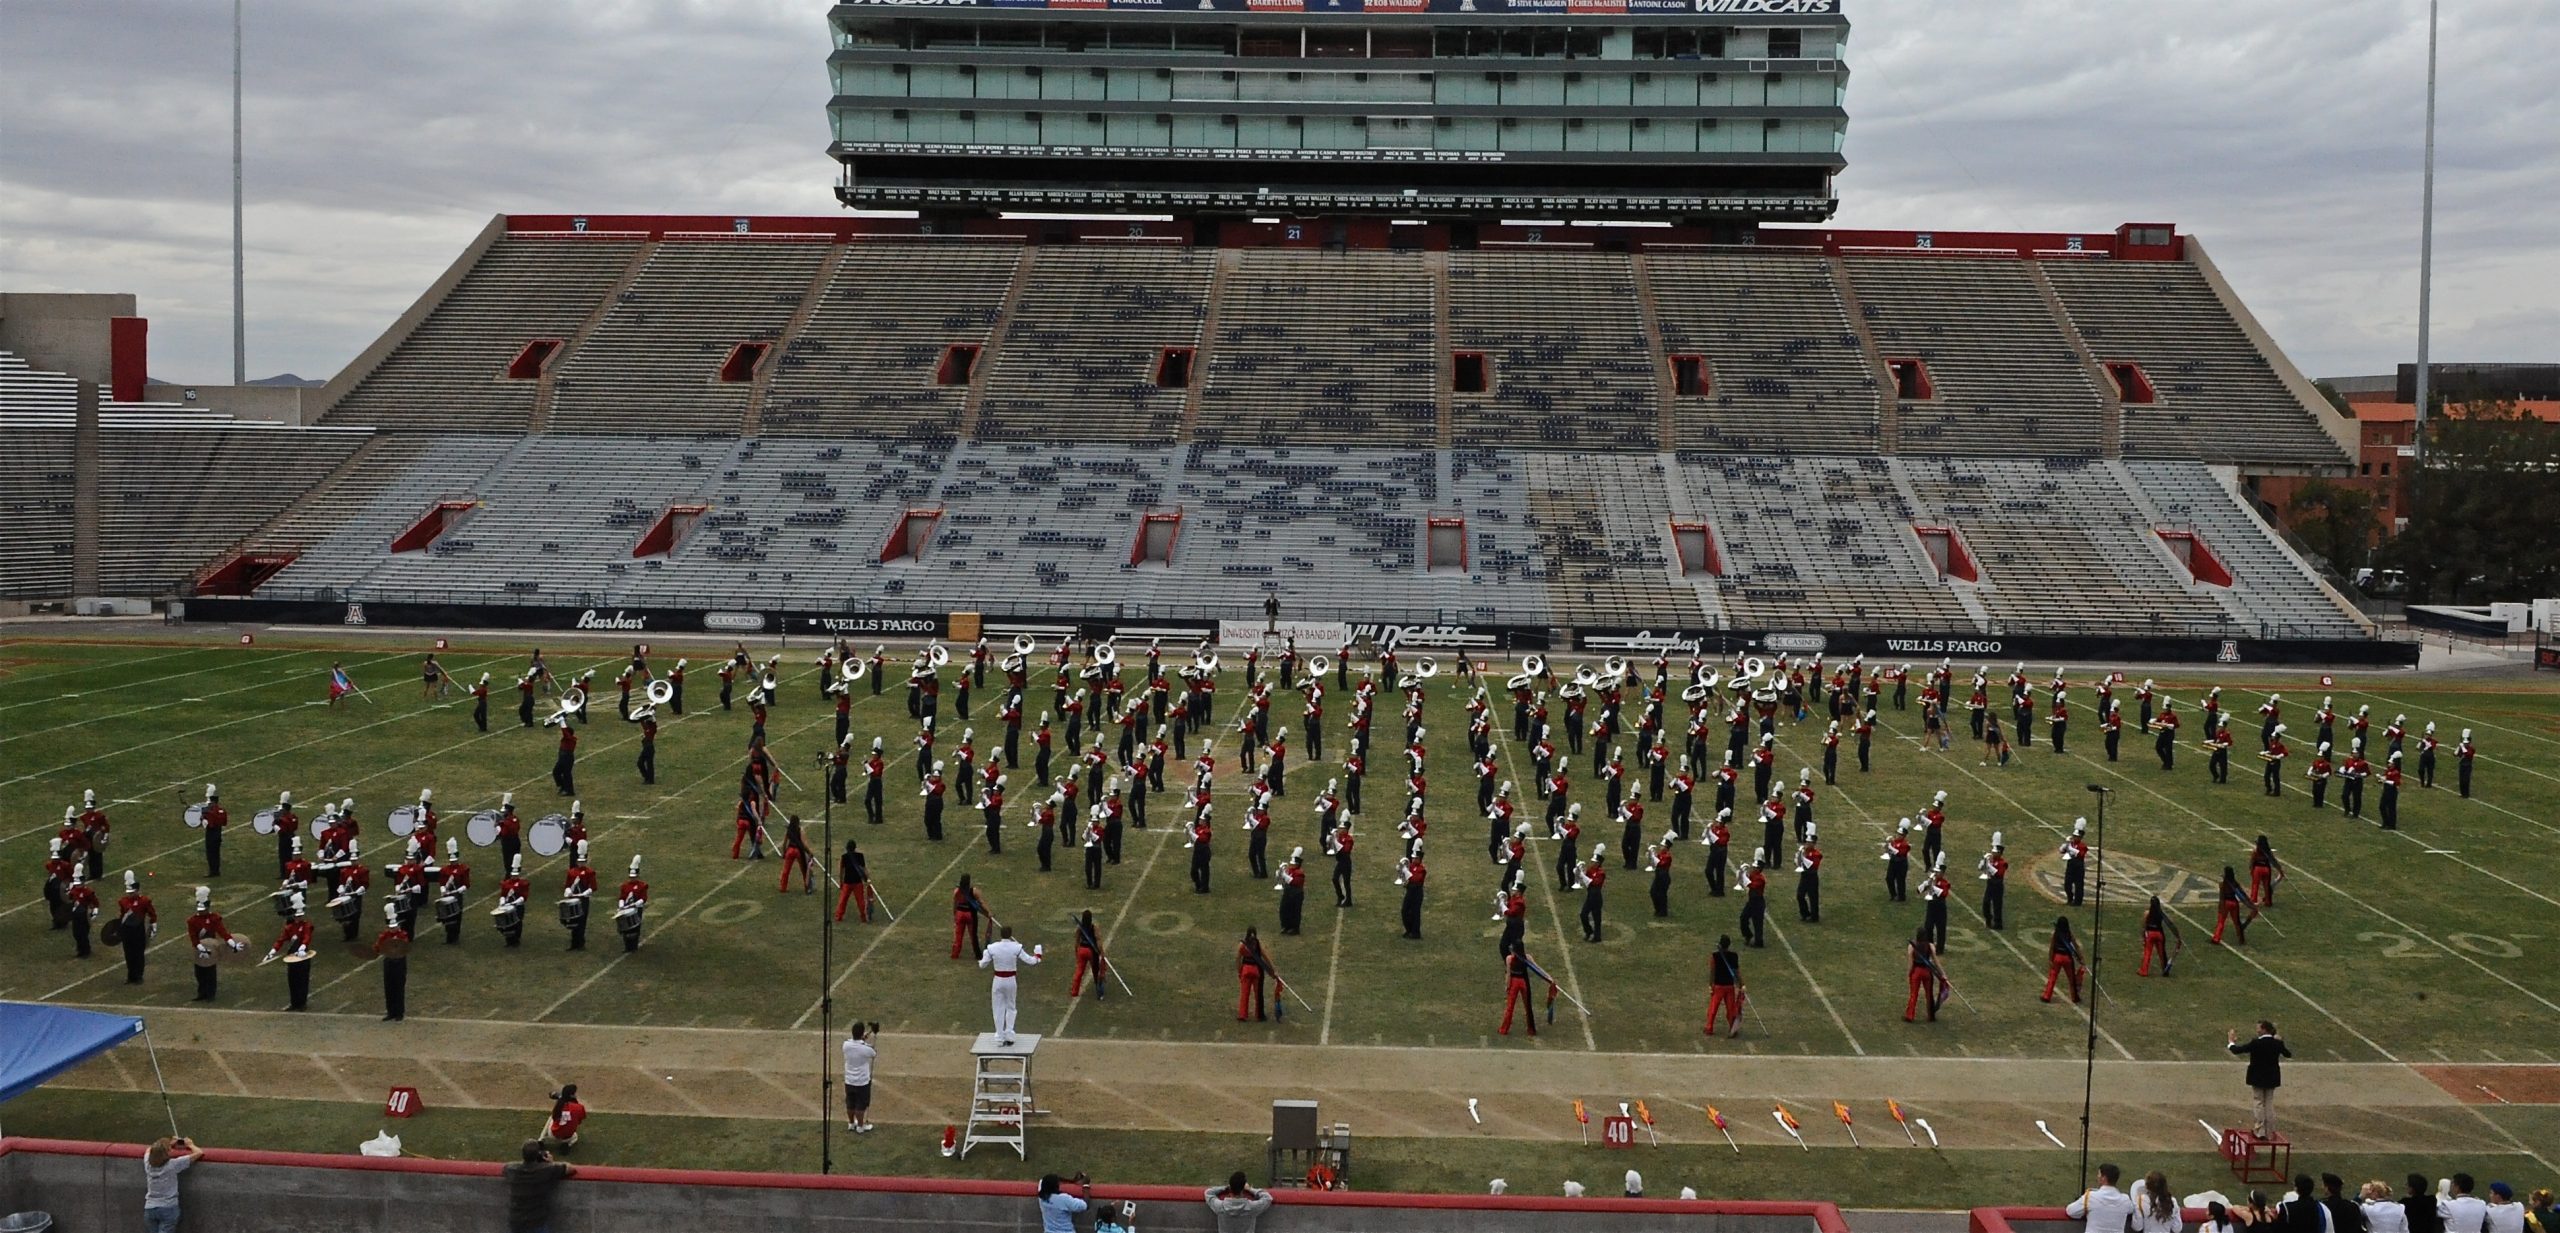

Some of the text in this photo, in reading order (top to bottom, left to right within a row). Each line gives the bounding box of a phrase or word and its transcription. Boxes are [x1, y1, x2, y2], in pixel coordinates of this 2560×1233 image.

[1695, 0, 1833, 12] WILDCATS
[575, 222, 586, 231] 17
[736, 223, 748, 232] 18
[920, 226, 932, 235] 19
[1129, 228, 1143, 237] 20
[1288, 229, 1300, 239] 21
[1528, 233, 1542, 243] 22
[1742, 236, 1755, 245] 23
[1917, 239, 1932, 248] 24
[2067, 241, 2082, 251] 25
[185, 391, 196, 400] 16
[576, 609, 647, 629] Bashas'
[726, 616, 759, 625] CASINOS
[823, 619, 935, 632] WELLS FARGO
[1222, 628, 1260, 640] UNIVERSITY
[1305, 629, 1326, 640] BAND
[1327, 630, 1341, 641] DAY
[1786, 637, 1821, 647] CASINOS
[1887, 640, 2002, 653] WELLS FARGO
[2355, 930, 2525, 959] 20
[388, 1091, 409, 1113] 40
[1608, 1121, 1628, 1144] 40
